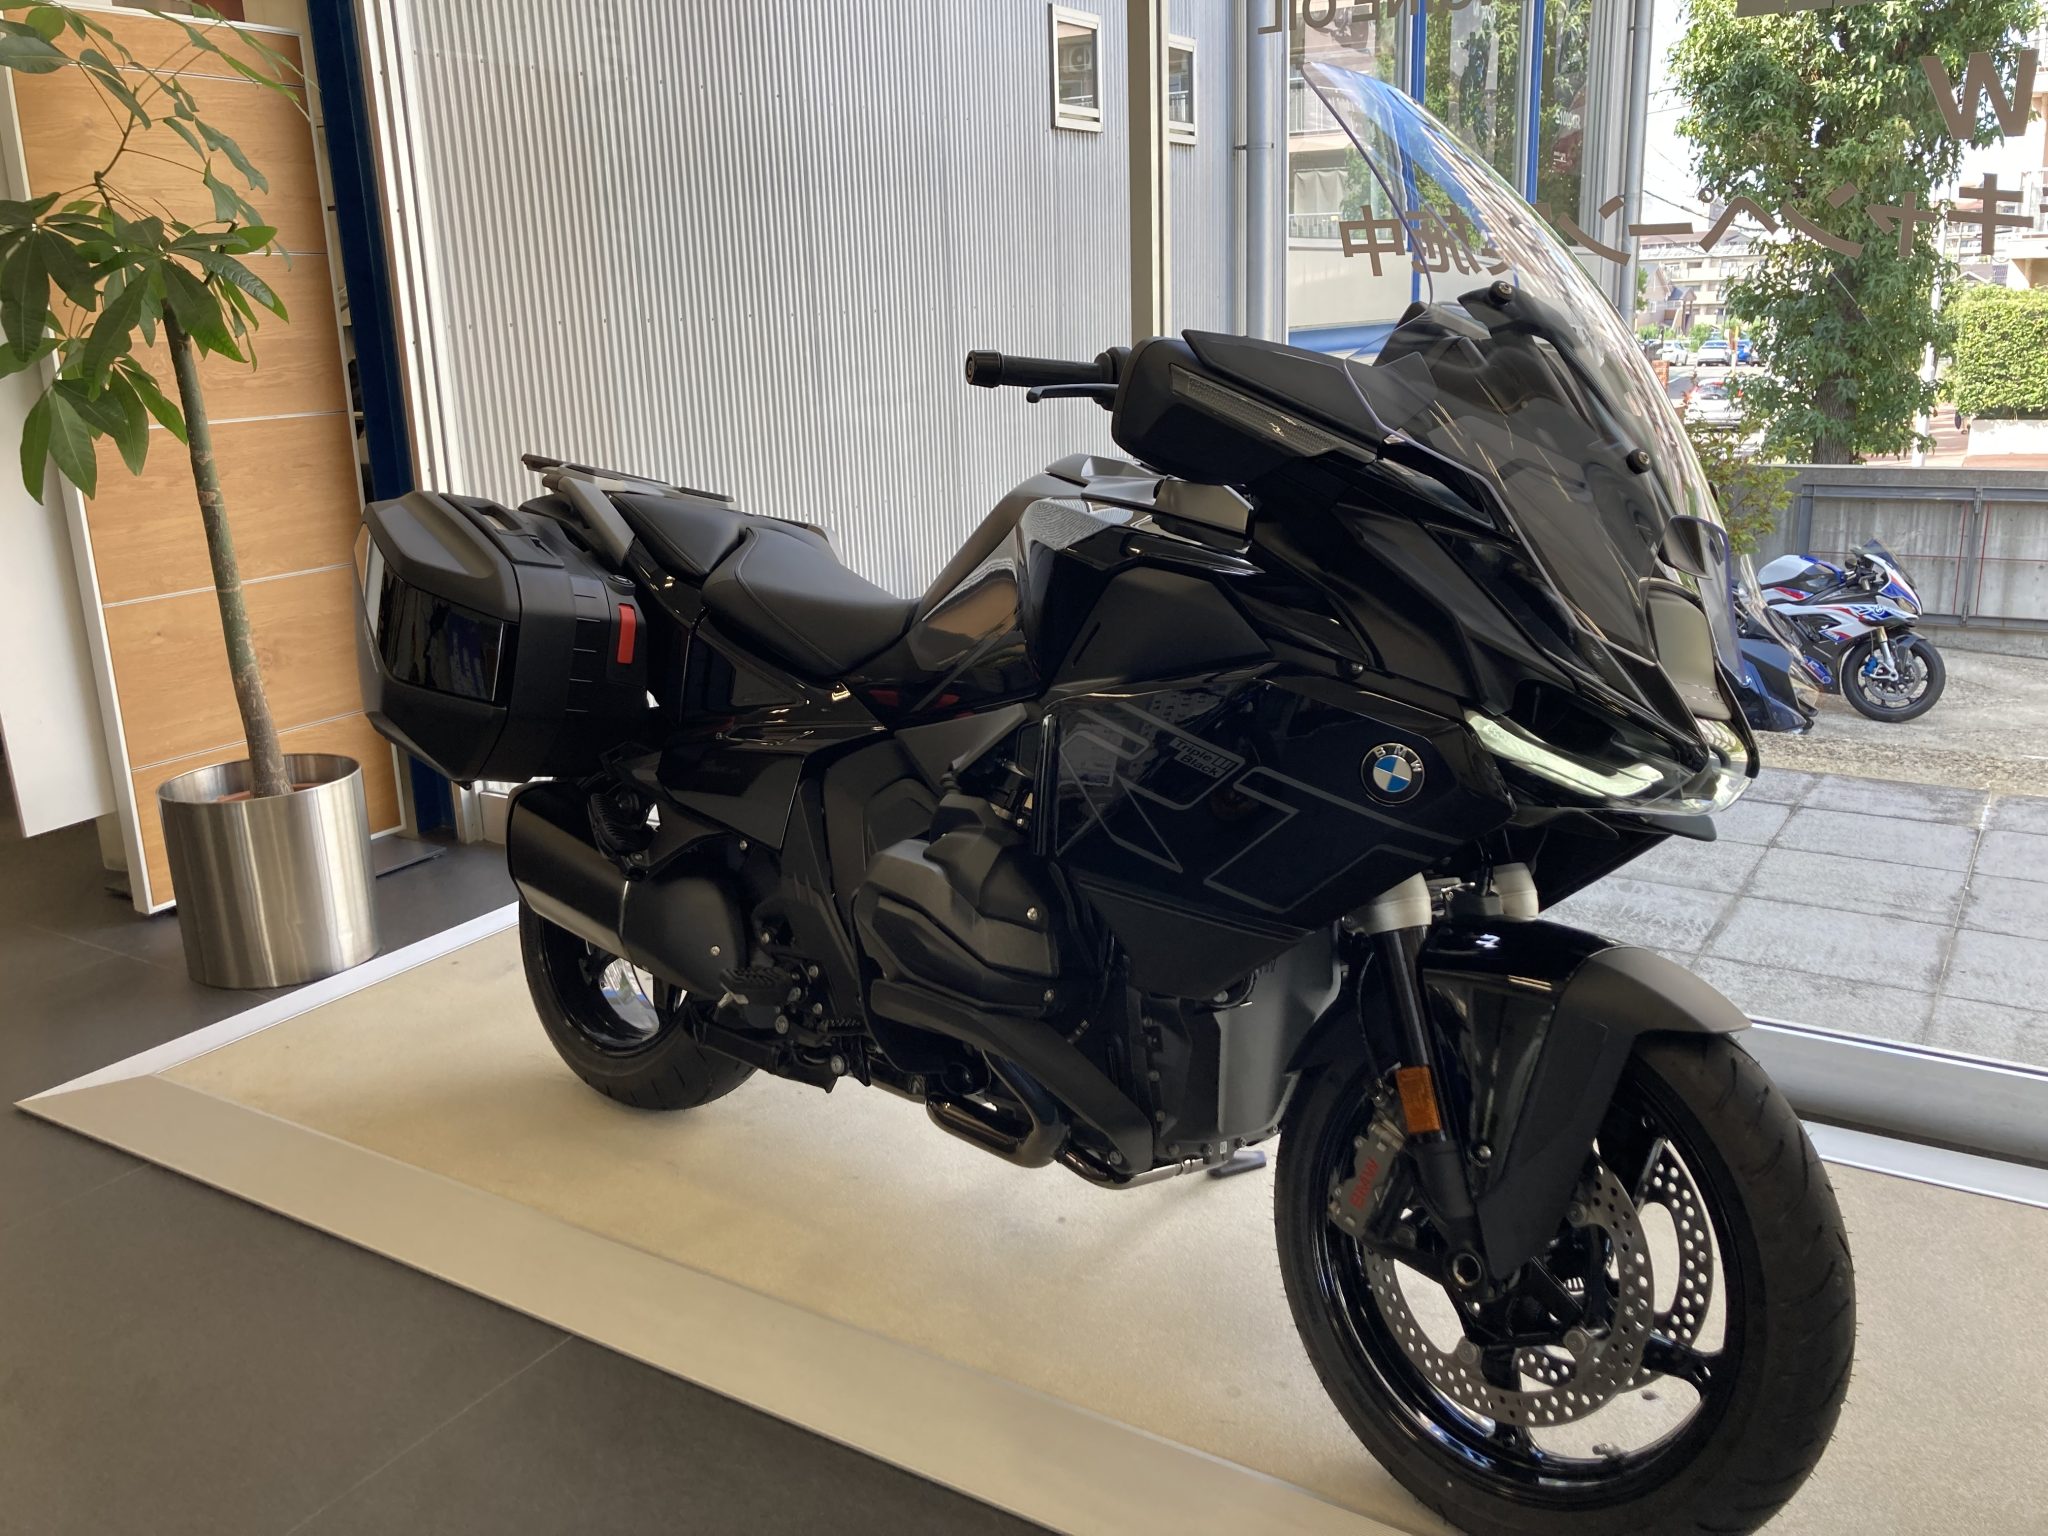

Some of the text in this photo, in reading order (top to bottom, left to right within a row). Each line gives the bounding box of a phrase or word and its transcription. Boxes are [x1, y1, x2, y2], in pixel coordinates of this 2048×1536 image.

[1175, 738, 1213, 761] Triple
[1373, 743, 1423, 773] BMW
[1180, 754, 1219, 777] Black
[1350, 1158, 1379, 1209] BMW
